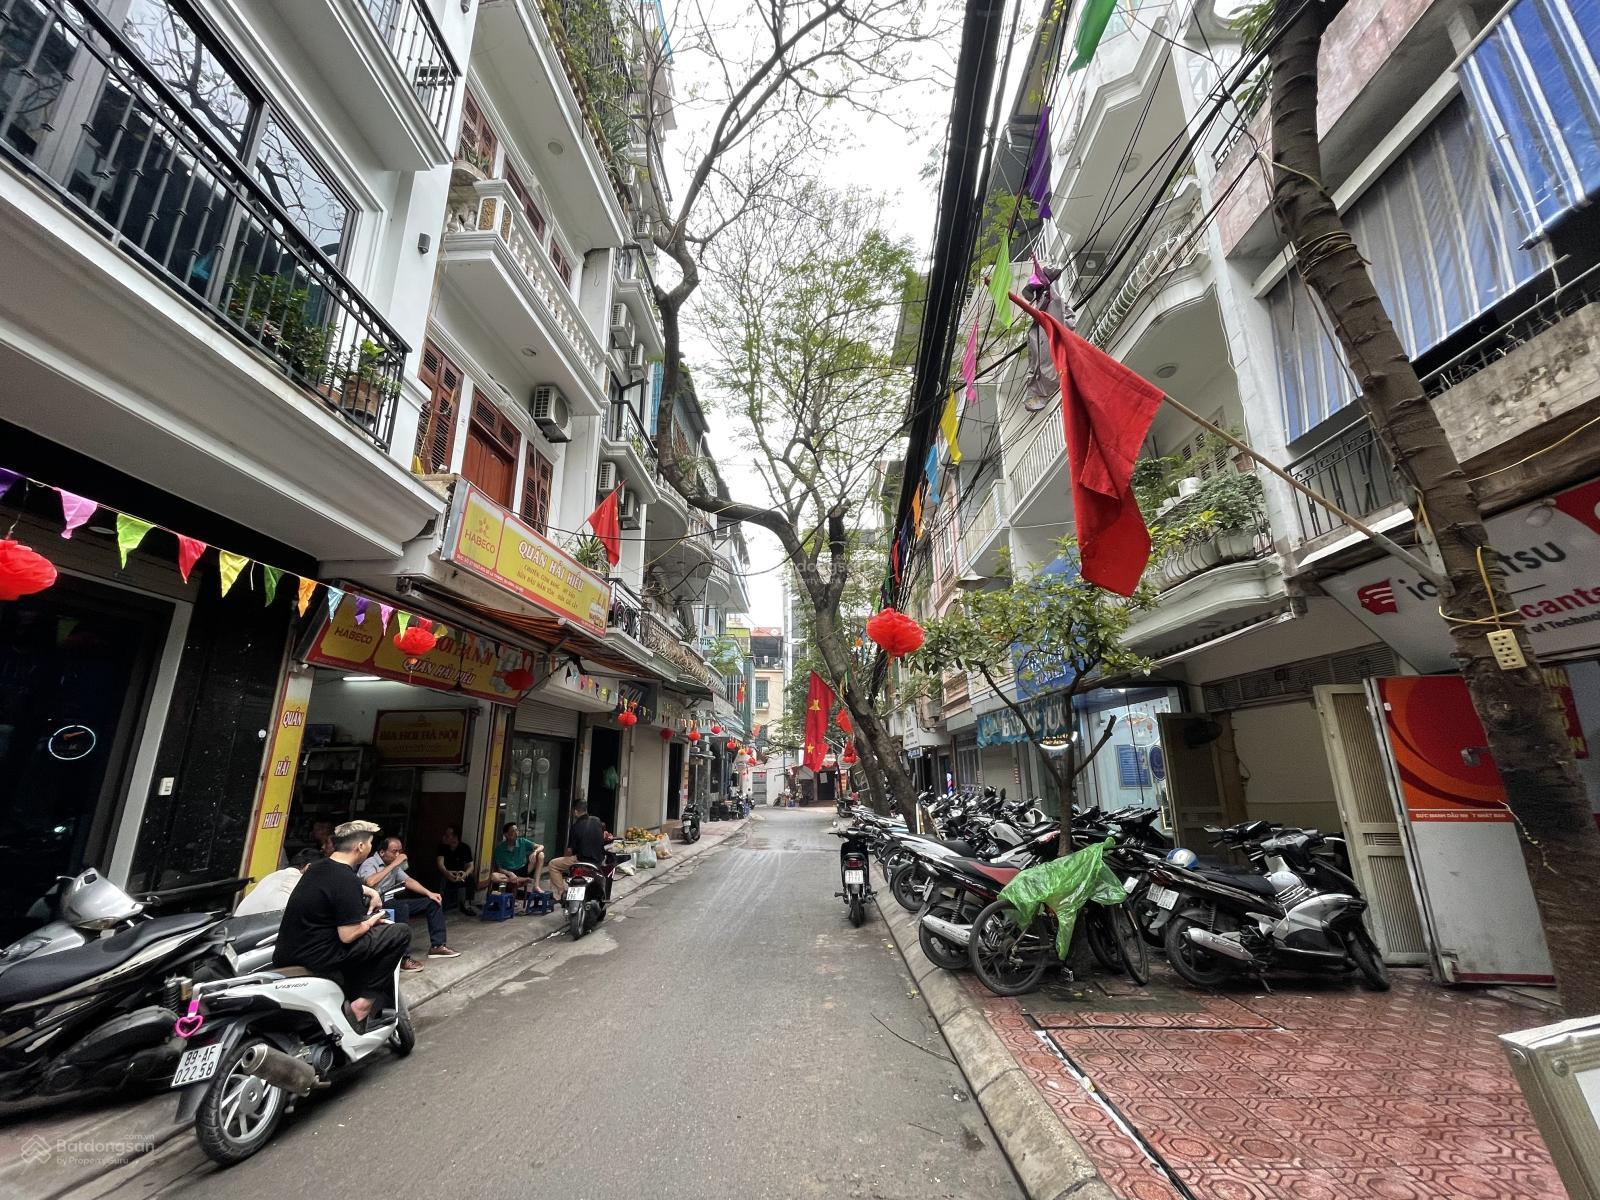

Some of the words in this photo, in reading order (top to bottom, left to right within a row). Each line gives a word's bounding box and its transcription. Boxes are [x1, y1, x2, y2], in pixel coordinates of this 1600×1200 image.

[464, 529, 496, 554] HABECO
[518, 541, 548, 570] QUÁN
[548, 561, 565, 580] HẢI
[566, 572, 585, 593] HIẾU
[334, 626, 373, 645] HABECO
[282, 706, 305, 728] QUÁN
[274, 755, 291, 777] HẢI
[184, 1045, 216, 1066] 89-AF
